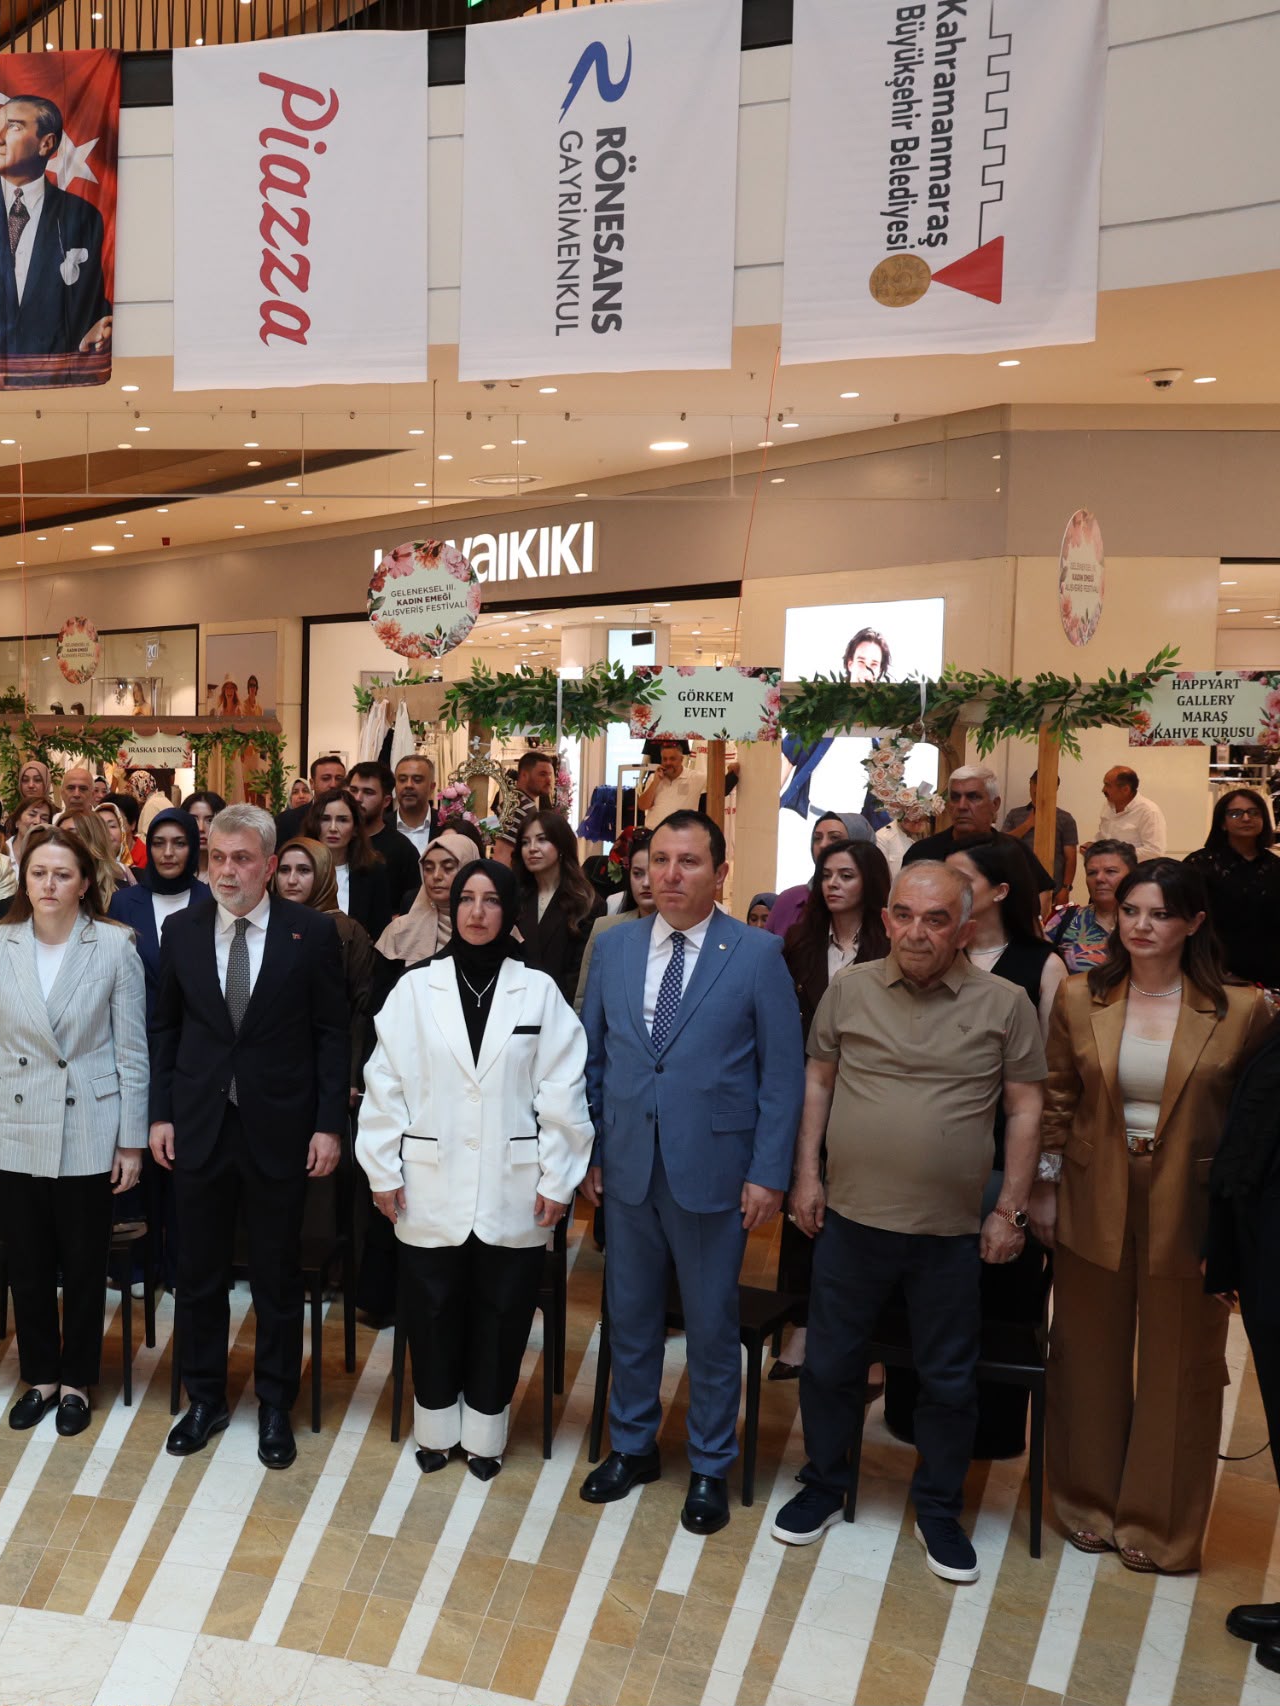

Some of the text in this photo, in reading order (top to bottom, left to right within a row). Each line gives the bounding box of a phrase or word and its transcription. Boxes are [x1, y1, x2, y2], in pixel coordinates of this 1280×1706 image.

[880, 4, 926, 251] Büyükşehir Belediyesi
[918, 0, 967, 248] Kahramanmaraş
[258, 72, 339, 347] Piazza
[556, 130, 587, 336] GAYRİMENKUL
[591, 127, 637, 334] RÖNESANS
[390, 585, 444, 598] GELENEKSEL
[396, 593, 452, 606] KADIN EMEĞİ
[381, 600, 468, 617] ALIŞVERİŞ FESTİVALİ
[1172, 679, 1241, 690] HAPPYART
[677, 688, 734, 703] GÖRKEM
[1177, 695, 1235, 706] GALLERY
[684, 707, 726, 718] EVENT
[1182, 711, 1228, 724] MARAŞ
[1154, 727, 1255, 739] KAHVE KURUSU
